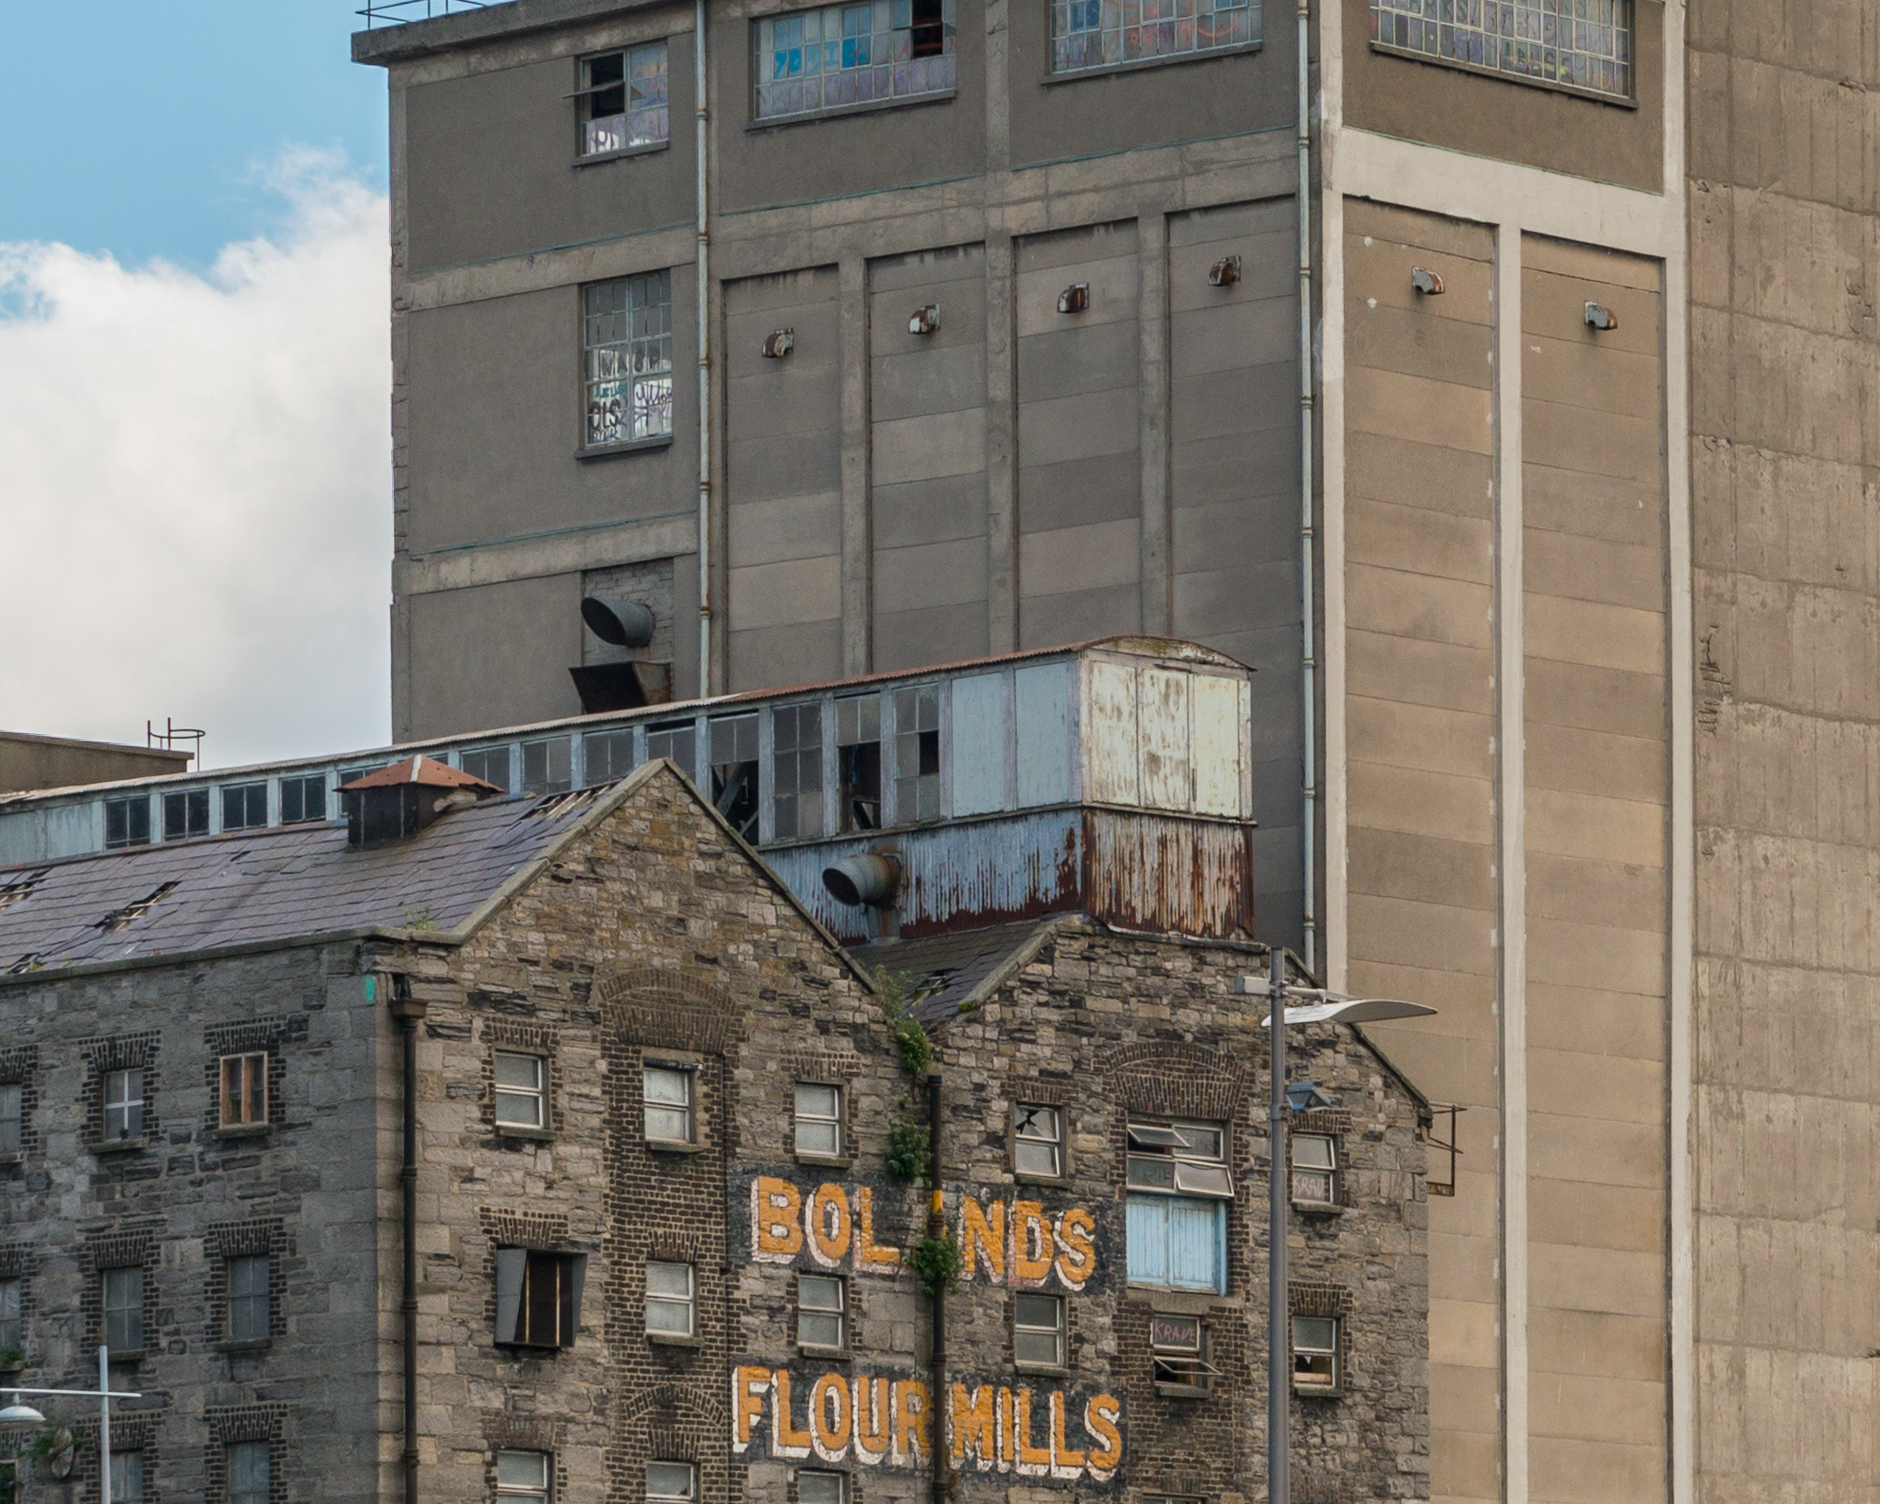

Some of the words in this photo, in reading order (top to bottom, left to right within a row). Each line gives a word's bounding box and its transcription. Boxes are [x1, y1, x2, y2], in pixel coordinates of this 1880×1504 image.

[750, 1174, 1098, 1293] BOLNDS
[731, 1365, 933, 1467] FLOUR
[948, 1382, 1125, 1482] MILLS
